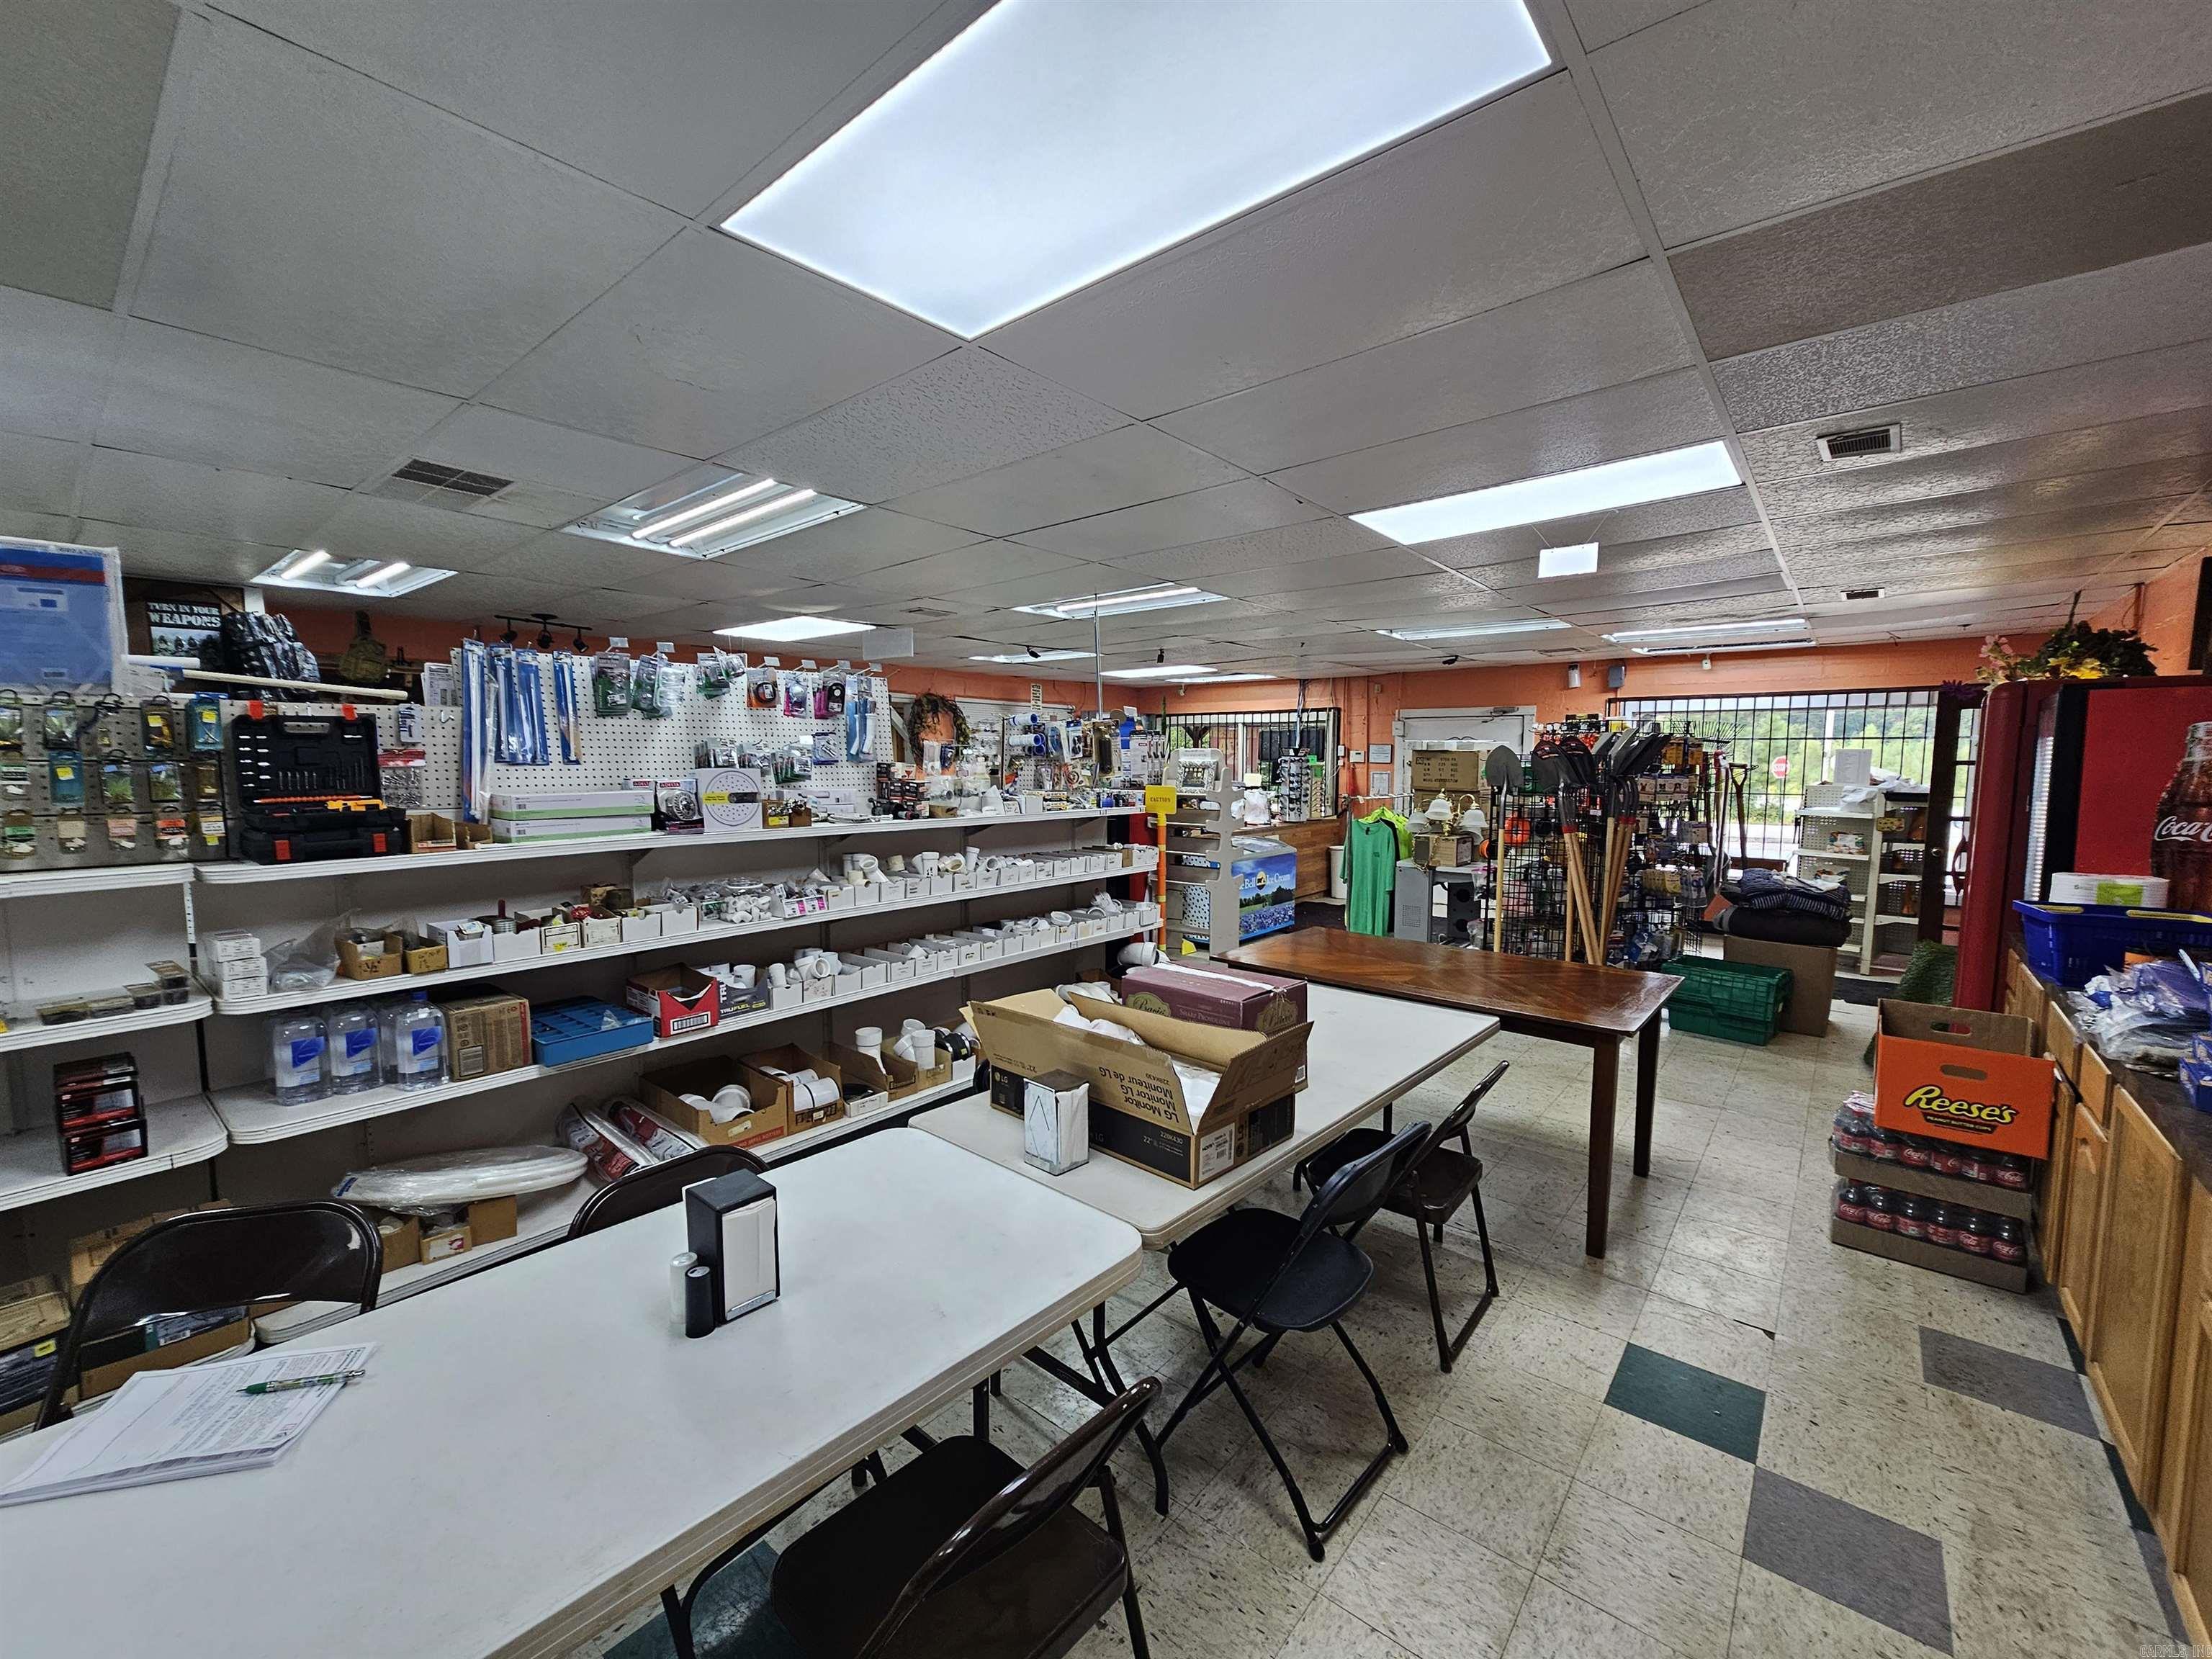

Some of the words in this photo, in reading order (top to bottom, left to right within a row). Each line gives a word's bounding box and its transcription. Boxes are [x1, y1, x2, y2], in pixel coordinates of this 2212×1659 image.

[147, 602, 176, 612] TURN
[192, 606, 220, 615] YOUR
[147, 612, 221, 627] WEAPONS
[1245, 877, 1256, 888] Bell
[1099, 1066, 1112, 1079] LG
[1113, 1071, 1125, 1083] de
[1120, 1084, 1135, 1097] LG
[1128, 1076, 1174, 1100] Moniteur
[1124, 1095, 1162, 1117] Monitor
[1136, 1089, 1177, 1112] Monitor
[1905, 1086, 2017, 1123] Reese's
[1164, 1110, 1180, 1123] LG
[1926, 1115, 1950, 1124] PEANUT
[1951, 1120, 1974, 1128] BUTTER
